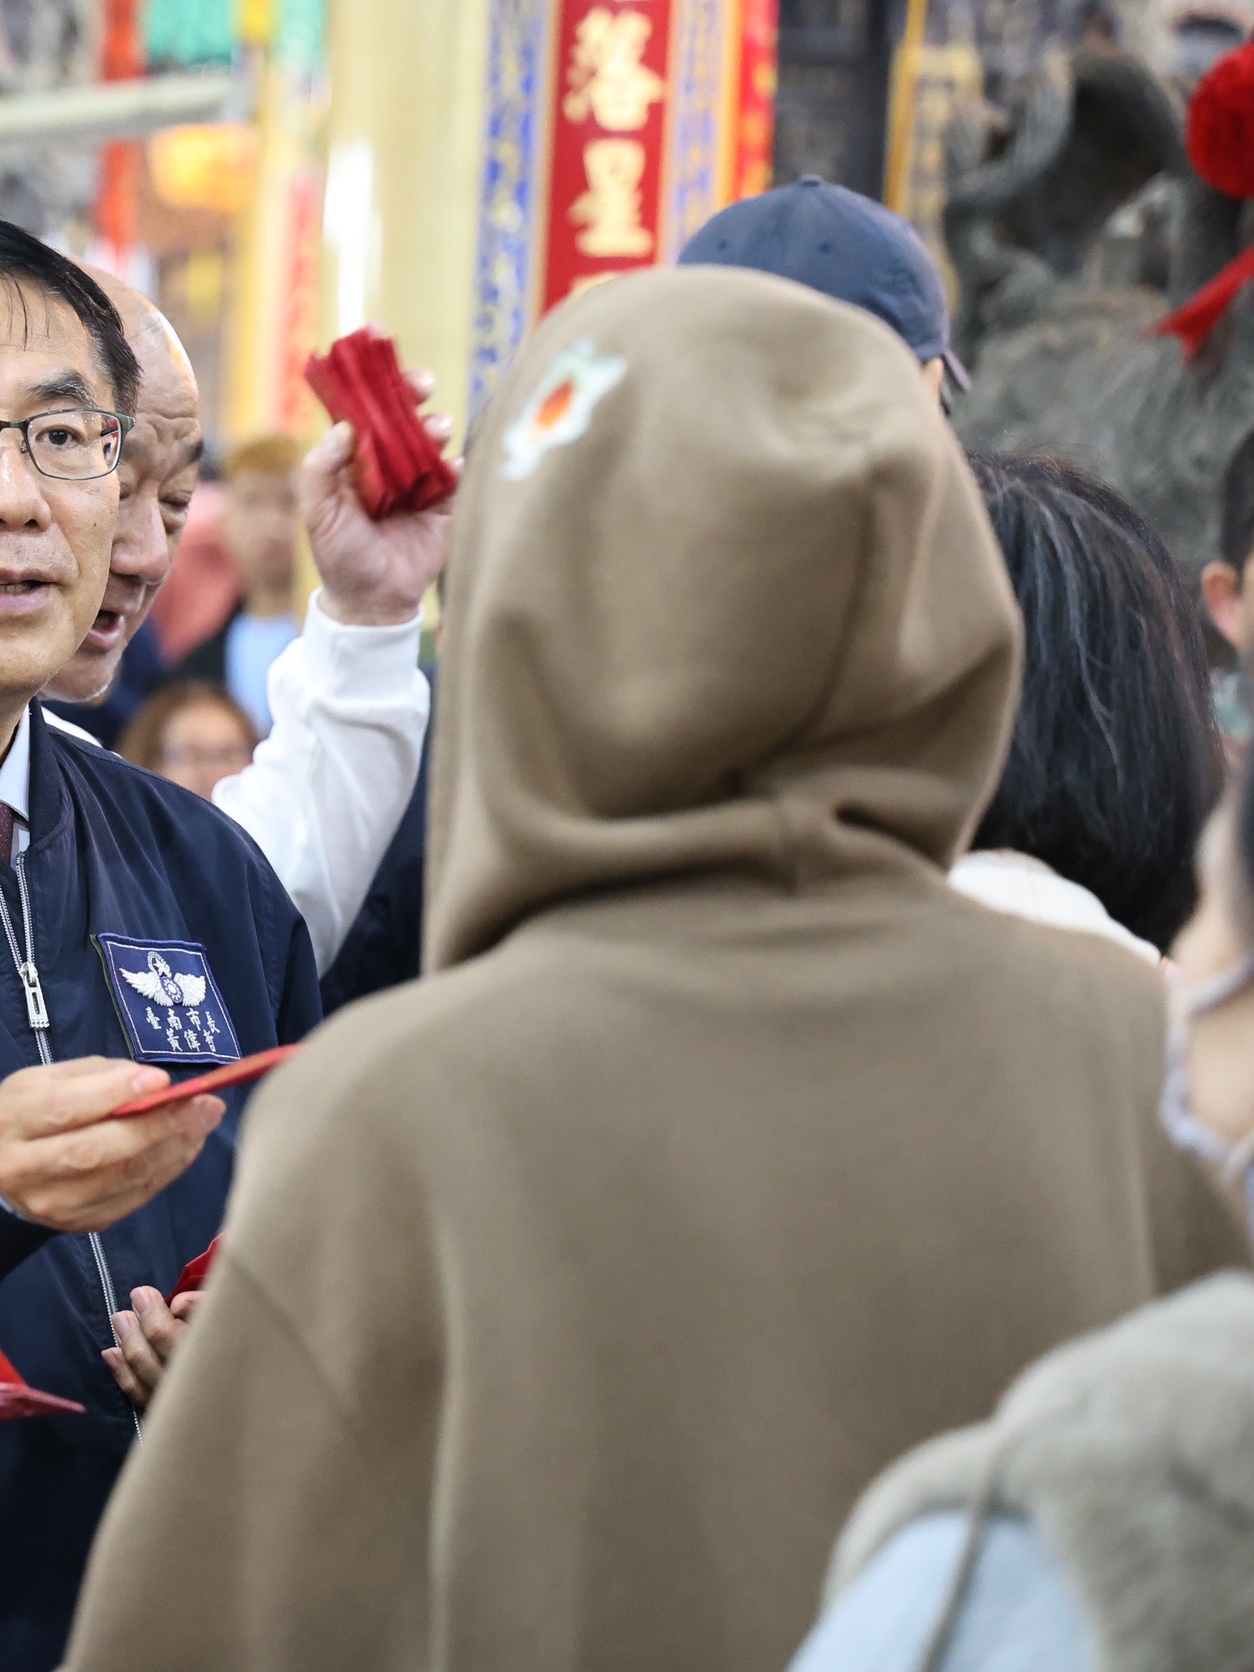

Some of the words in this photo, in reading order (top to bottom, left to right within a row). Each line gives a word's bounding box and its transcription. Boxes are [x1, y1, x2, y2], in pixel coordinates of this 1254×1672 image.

[145, 1006, 221, 1034] 臺南市長
[165, 1027, 217, 1053] 黃偉哲
